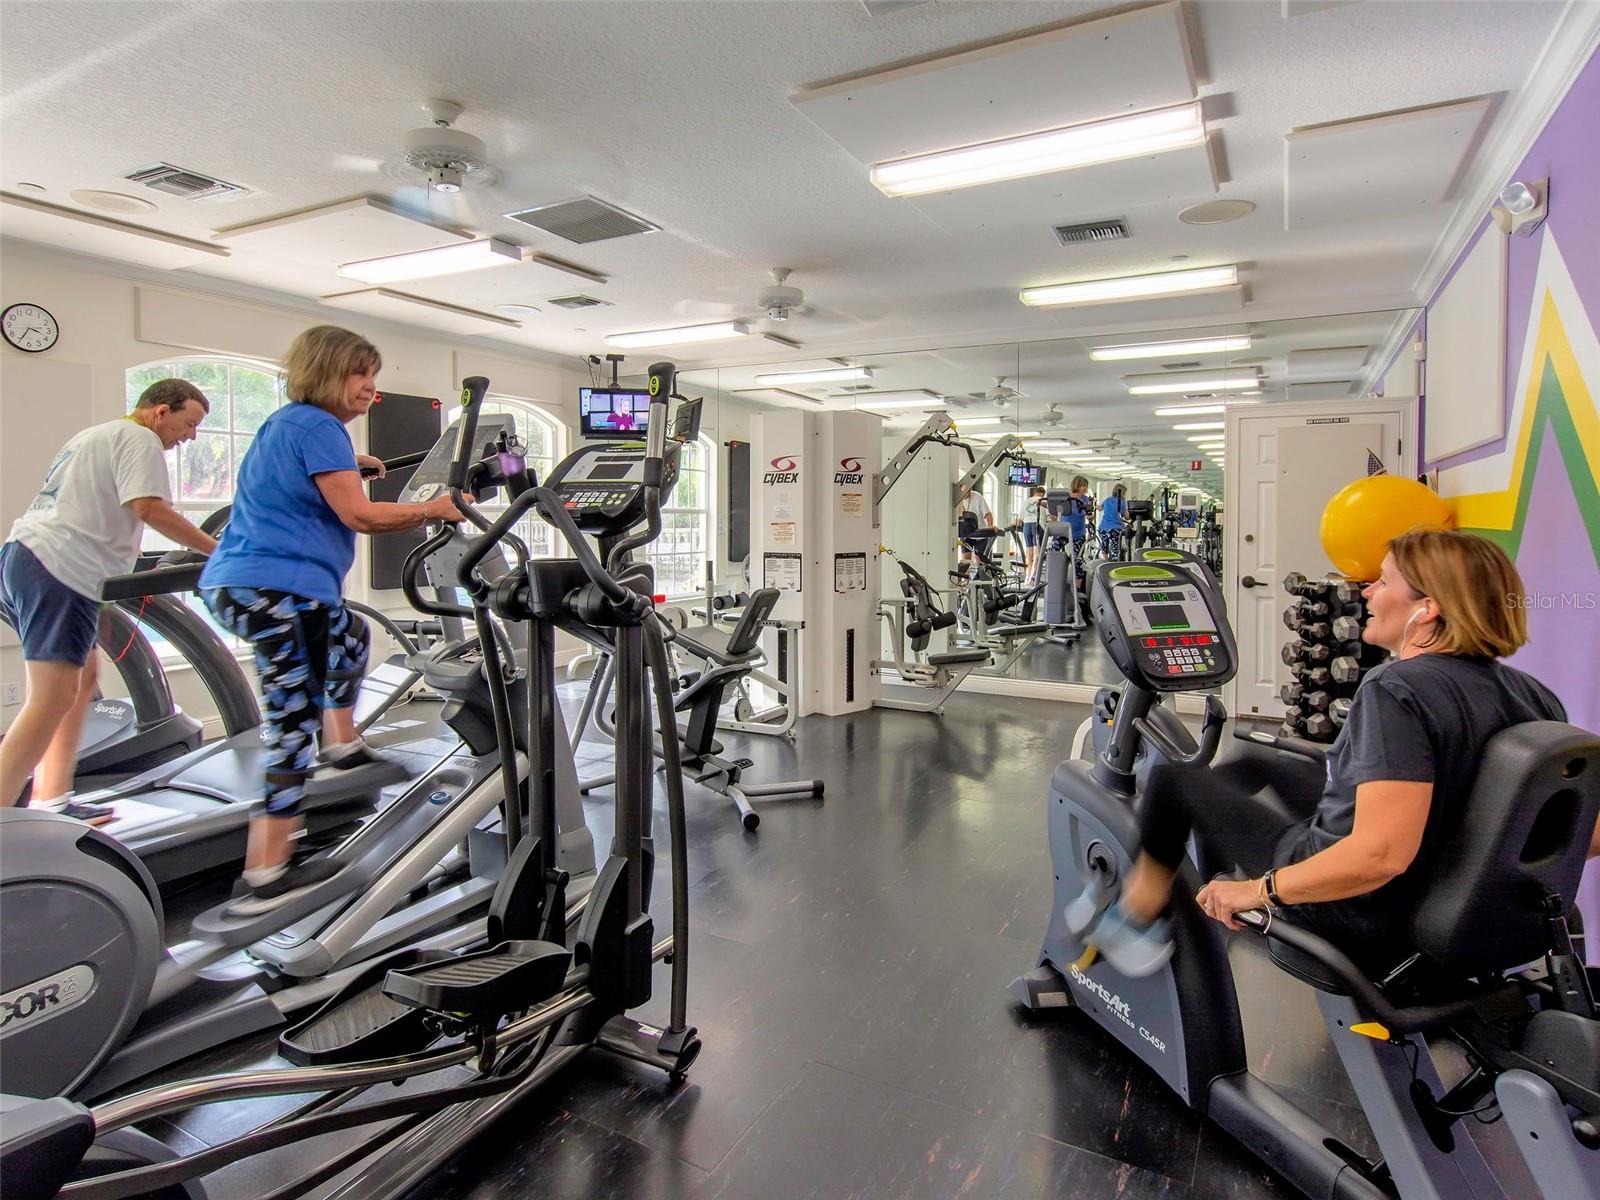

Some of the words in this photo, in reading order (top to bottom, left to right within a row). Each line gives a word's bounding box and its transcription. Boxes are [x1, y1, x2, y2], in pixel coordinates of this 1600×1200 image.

[763, 472, 799, 486] CYBEX
[834, 472, 864, 486] CYBEX
[1070, 963, 1131, 1018] SportsArt
[1106, 1004, 1136, 1029] FITNESS
[1139, 1026, 1166, 1054] C545R
